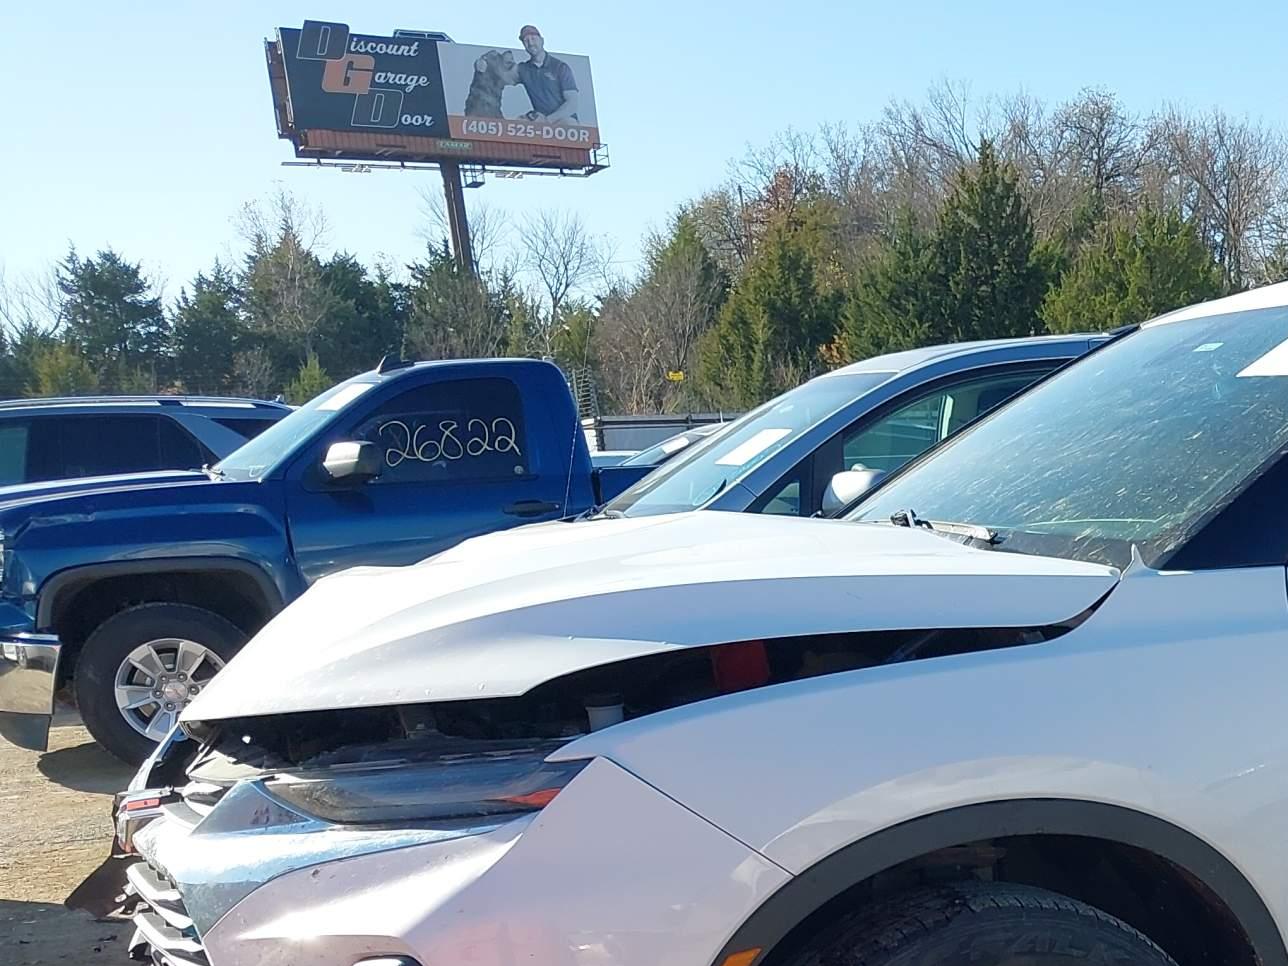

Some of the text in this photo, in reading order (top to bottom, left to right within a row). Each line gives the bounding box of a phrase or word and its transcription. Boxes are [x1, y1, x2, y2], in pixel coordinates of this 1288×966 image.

[462, 119, 590, 143] (405) 525-DOOR
[378, 417, 522, 467] 26822
